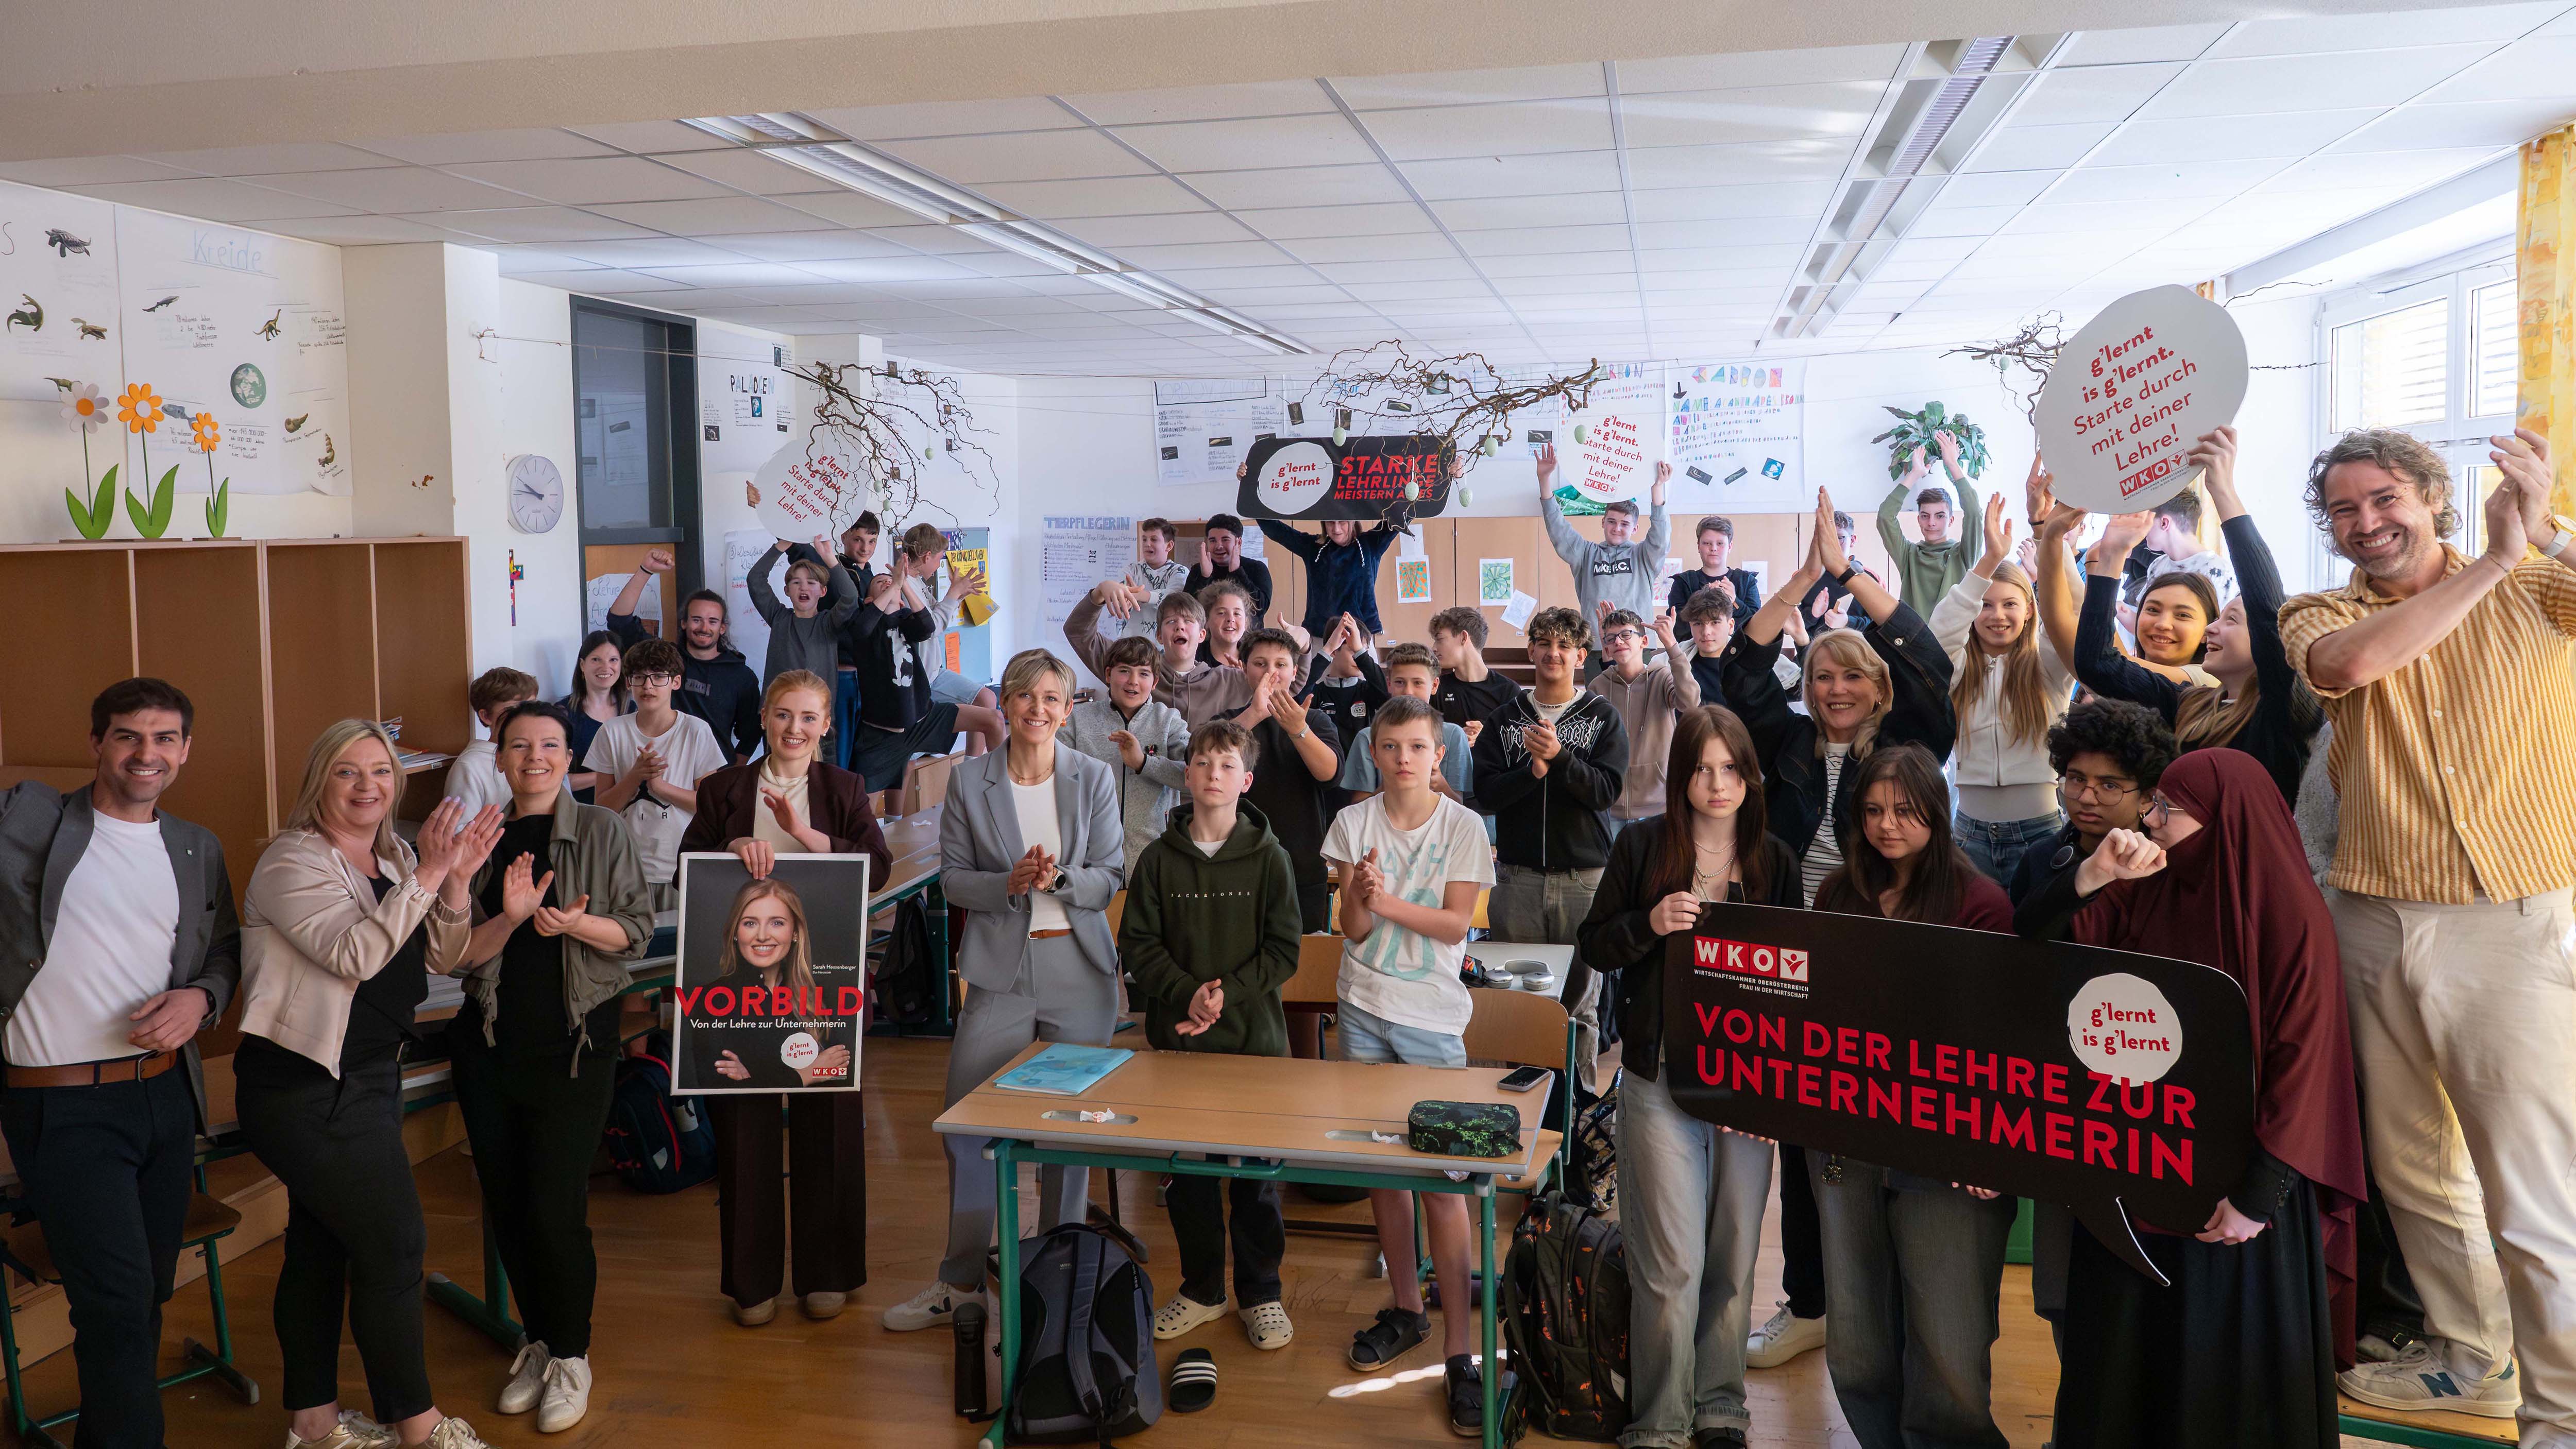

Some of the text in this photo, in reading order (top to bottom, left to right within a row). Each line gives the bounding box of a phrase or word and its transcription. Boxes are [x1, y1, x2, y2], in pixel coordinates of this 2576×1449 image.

[193, 228, 263, 272] Kreide
[2091, 326, 2154, 378] g'lernt
[2074, 359, 2197, 435] Starte durch
[2082, 386, 2098, 403] is
[1594, 425, 1601, 435] is
[1603, 415, 1637, 431] g'lernt
[2091, 393, 2191, 455] mit deiner
[1615, 446, 1642, 462] durch
[2115, 423, 2179, 471] Lehre!
[804, 462, 814, 470] is
[1278, 463, 1316, 477] g'lernt
[1340, 454, 1438, 474] STARKE
[1583, 453, 1633, 473] mit deiner
[788, 465, 814, 490] Starte
[1270, 476, 1320, 491] is g'lernt
[1589, 465, 1620, 483] Lehre!
[2120, 459, 2170, 496] WKO
[1334, 489, 1433, 500] MEISTERN AES
[1585, 478, 1609, 492] WKO
[777, 496, 808, 522] Lehre!
[781, 481, 824, 517] mit deiner
[1044, 516, 1130, 531] TIERPFLEGERIN
[1696, 939, 1775, 974] WKO
[1694, 969, 1809, 992] WIRTSCHAFTSKAMMER OBERÖSTERREICH
[675, 986, 863, 1016] VORBILD
[1773, 989, 1809, 999] WIRTSCHAFT
[690, 1019, 709, 1028] Von
[712, 1019, 727, 1028] der
[730, 1019, 756, 1028] Lehre
[775, 1018, 846, 1028] Unternehmerin
[2091, 1002, 2157, 1028] g'lernt
[2082, 1028, 2171, 1055] is g'lernt
[813, 1067, 838, 1076] WKO
[1694, 1002, 2196, 1130] VON DER LEHRE ZUR
[1697, 1045, 2193, 1187] UNTERNEHMERIN
